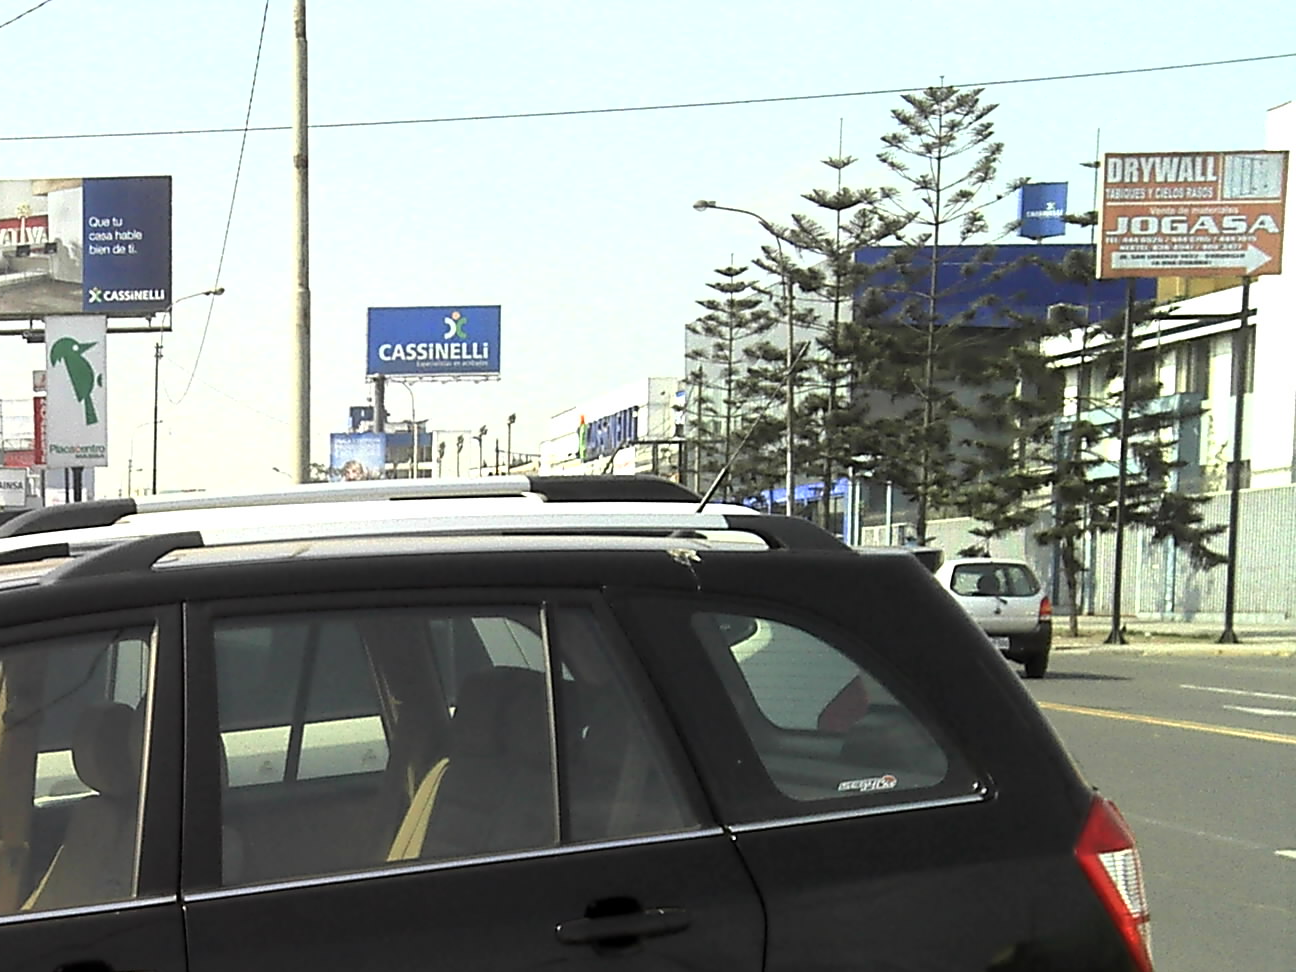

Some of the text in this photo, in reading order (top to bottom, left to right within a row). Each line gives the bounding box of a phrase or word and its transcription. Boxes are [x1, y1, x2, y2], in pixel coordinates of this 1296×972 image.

[1106, 155, 1218, 183] DRYWALL
[1155, 187, 1184, 199] CIELOS
[88, 216, 123, 228] Que tu
[1105, 215, 1280, 235] JOGASA
[88, 229, 143, 241] casa hable
[88, 244, 111, 255] bien
[112, 244, 126, 255] de
